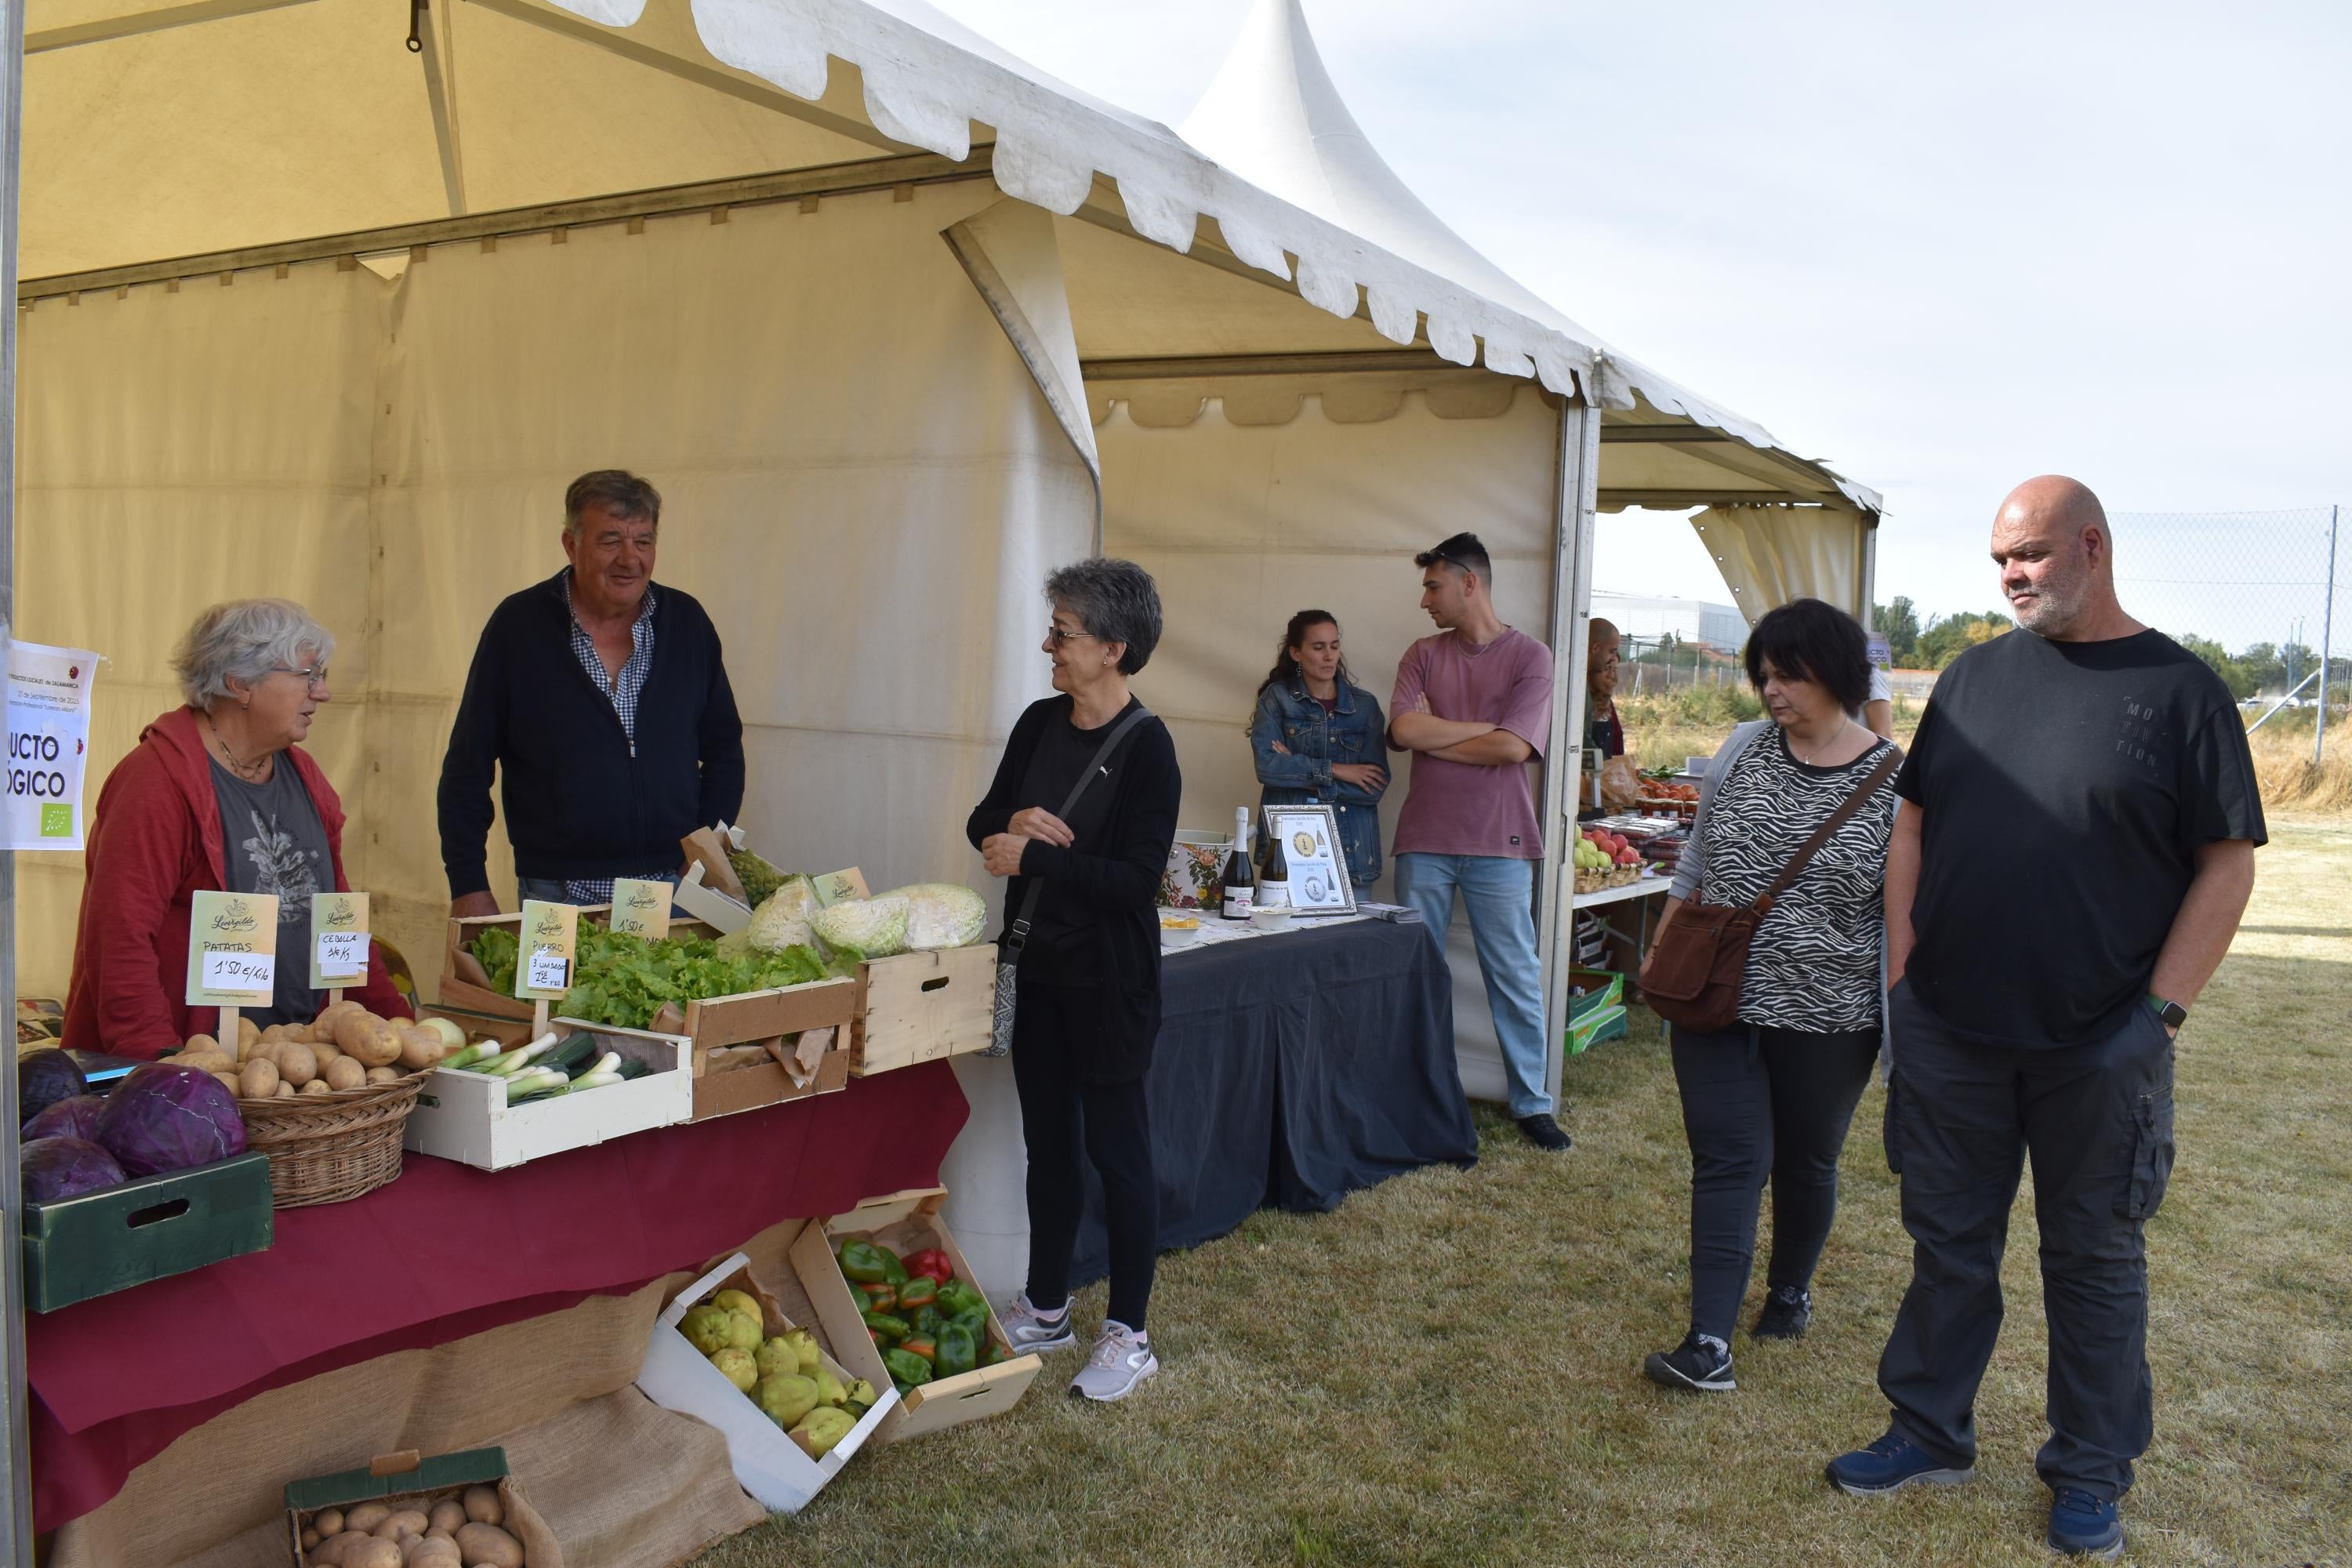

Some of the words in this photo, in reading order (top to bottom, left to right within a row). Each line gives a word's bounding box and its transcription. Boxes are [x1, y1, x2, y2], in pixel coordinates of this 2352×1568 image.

[52, 681, 79, 689] SALAMANCA
[8, 731, 60, 761] UCTO
[2115, 739, 2158, 768] TION
[211, 915, 255, 931] Leovigildo
[323, 935, 357, 943] CEBOLLA
[203, 941, 252, 953] PATATAS
[533, 940, 564, 953] PUERRO
[533, 958, 537, 967] 3
